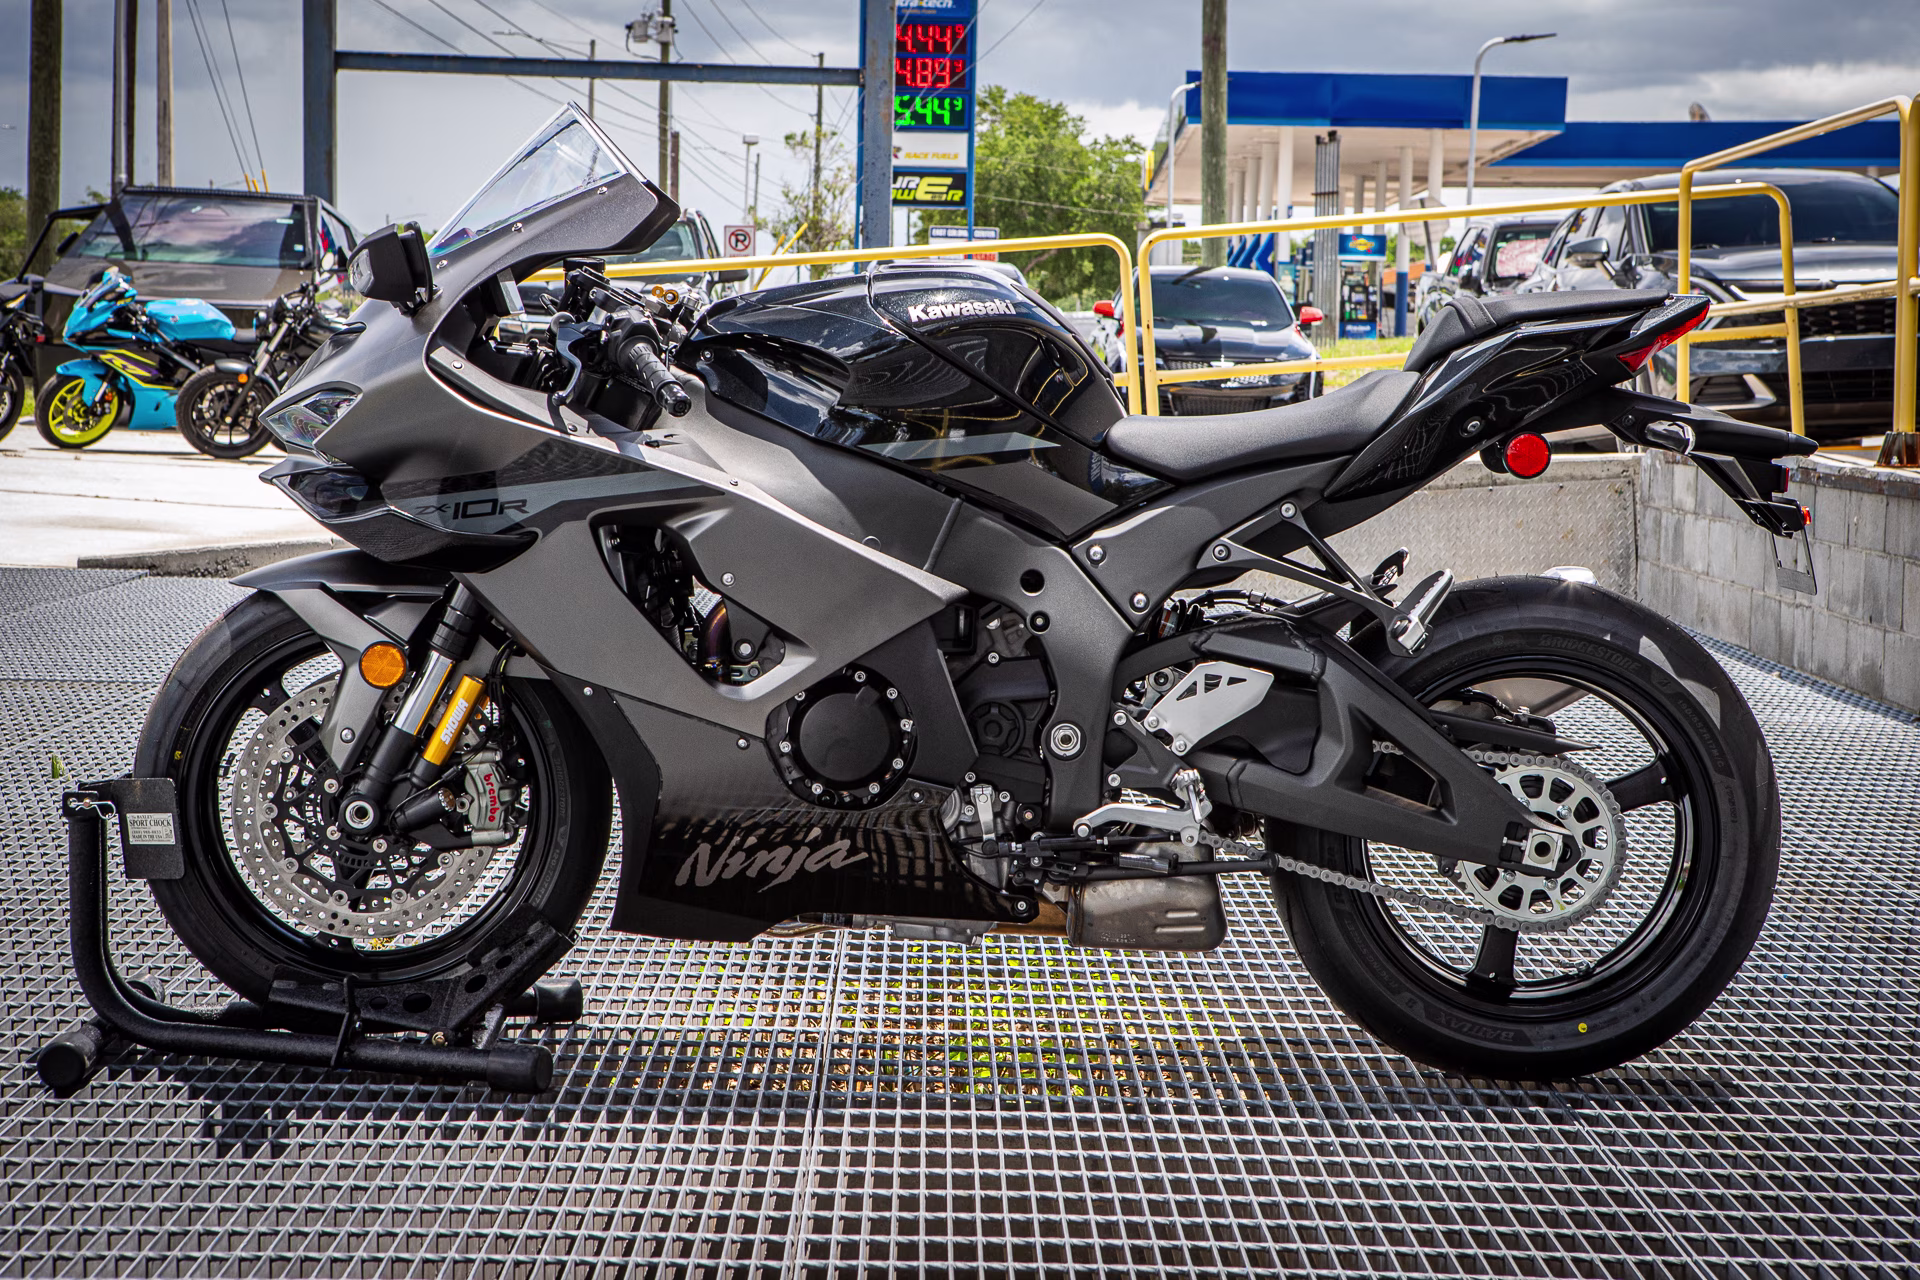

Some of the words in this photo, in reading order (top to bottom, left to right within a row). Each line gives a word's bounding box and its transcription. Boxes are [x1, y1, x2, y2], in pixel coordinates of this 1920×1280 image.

[908, 299, 1016, 323] Kawasaki
[415, 498, 529, 520] ZX-10R
[1540, 634, 1641, 672] BRIDGESTONE
[440, 698, 469, 745] SHOWA
[483, 773, 500, 822] brembo
[675, 827, 869, 893] Ninja
